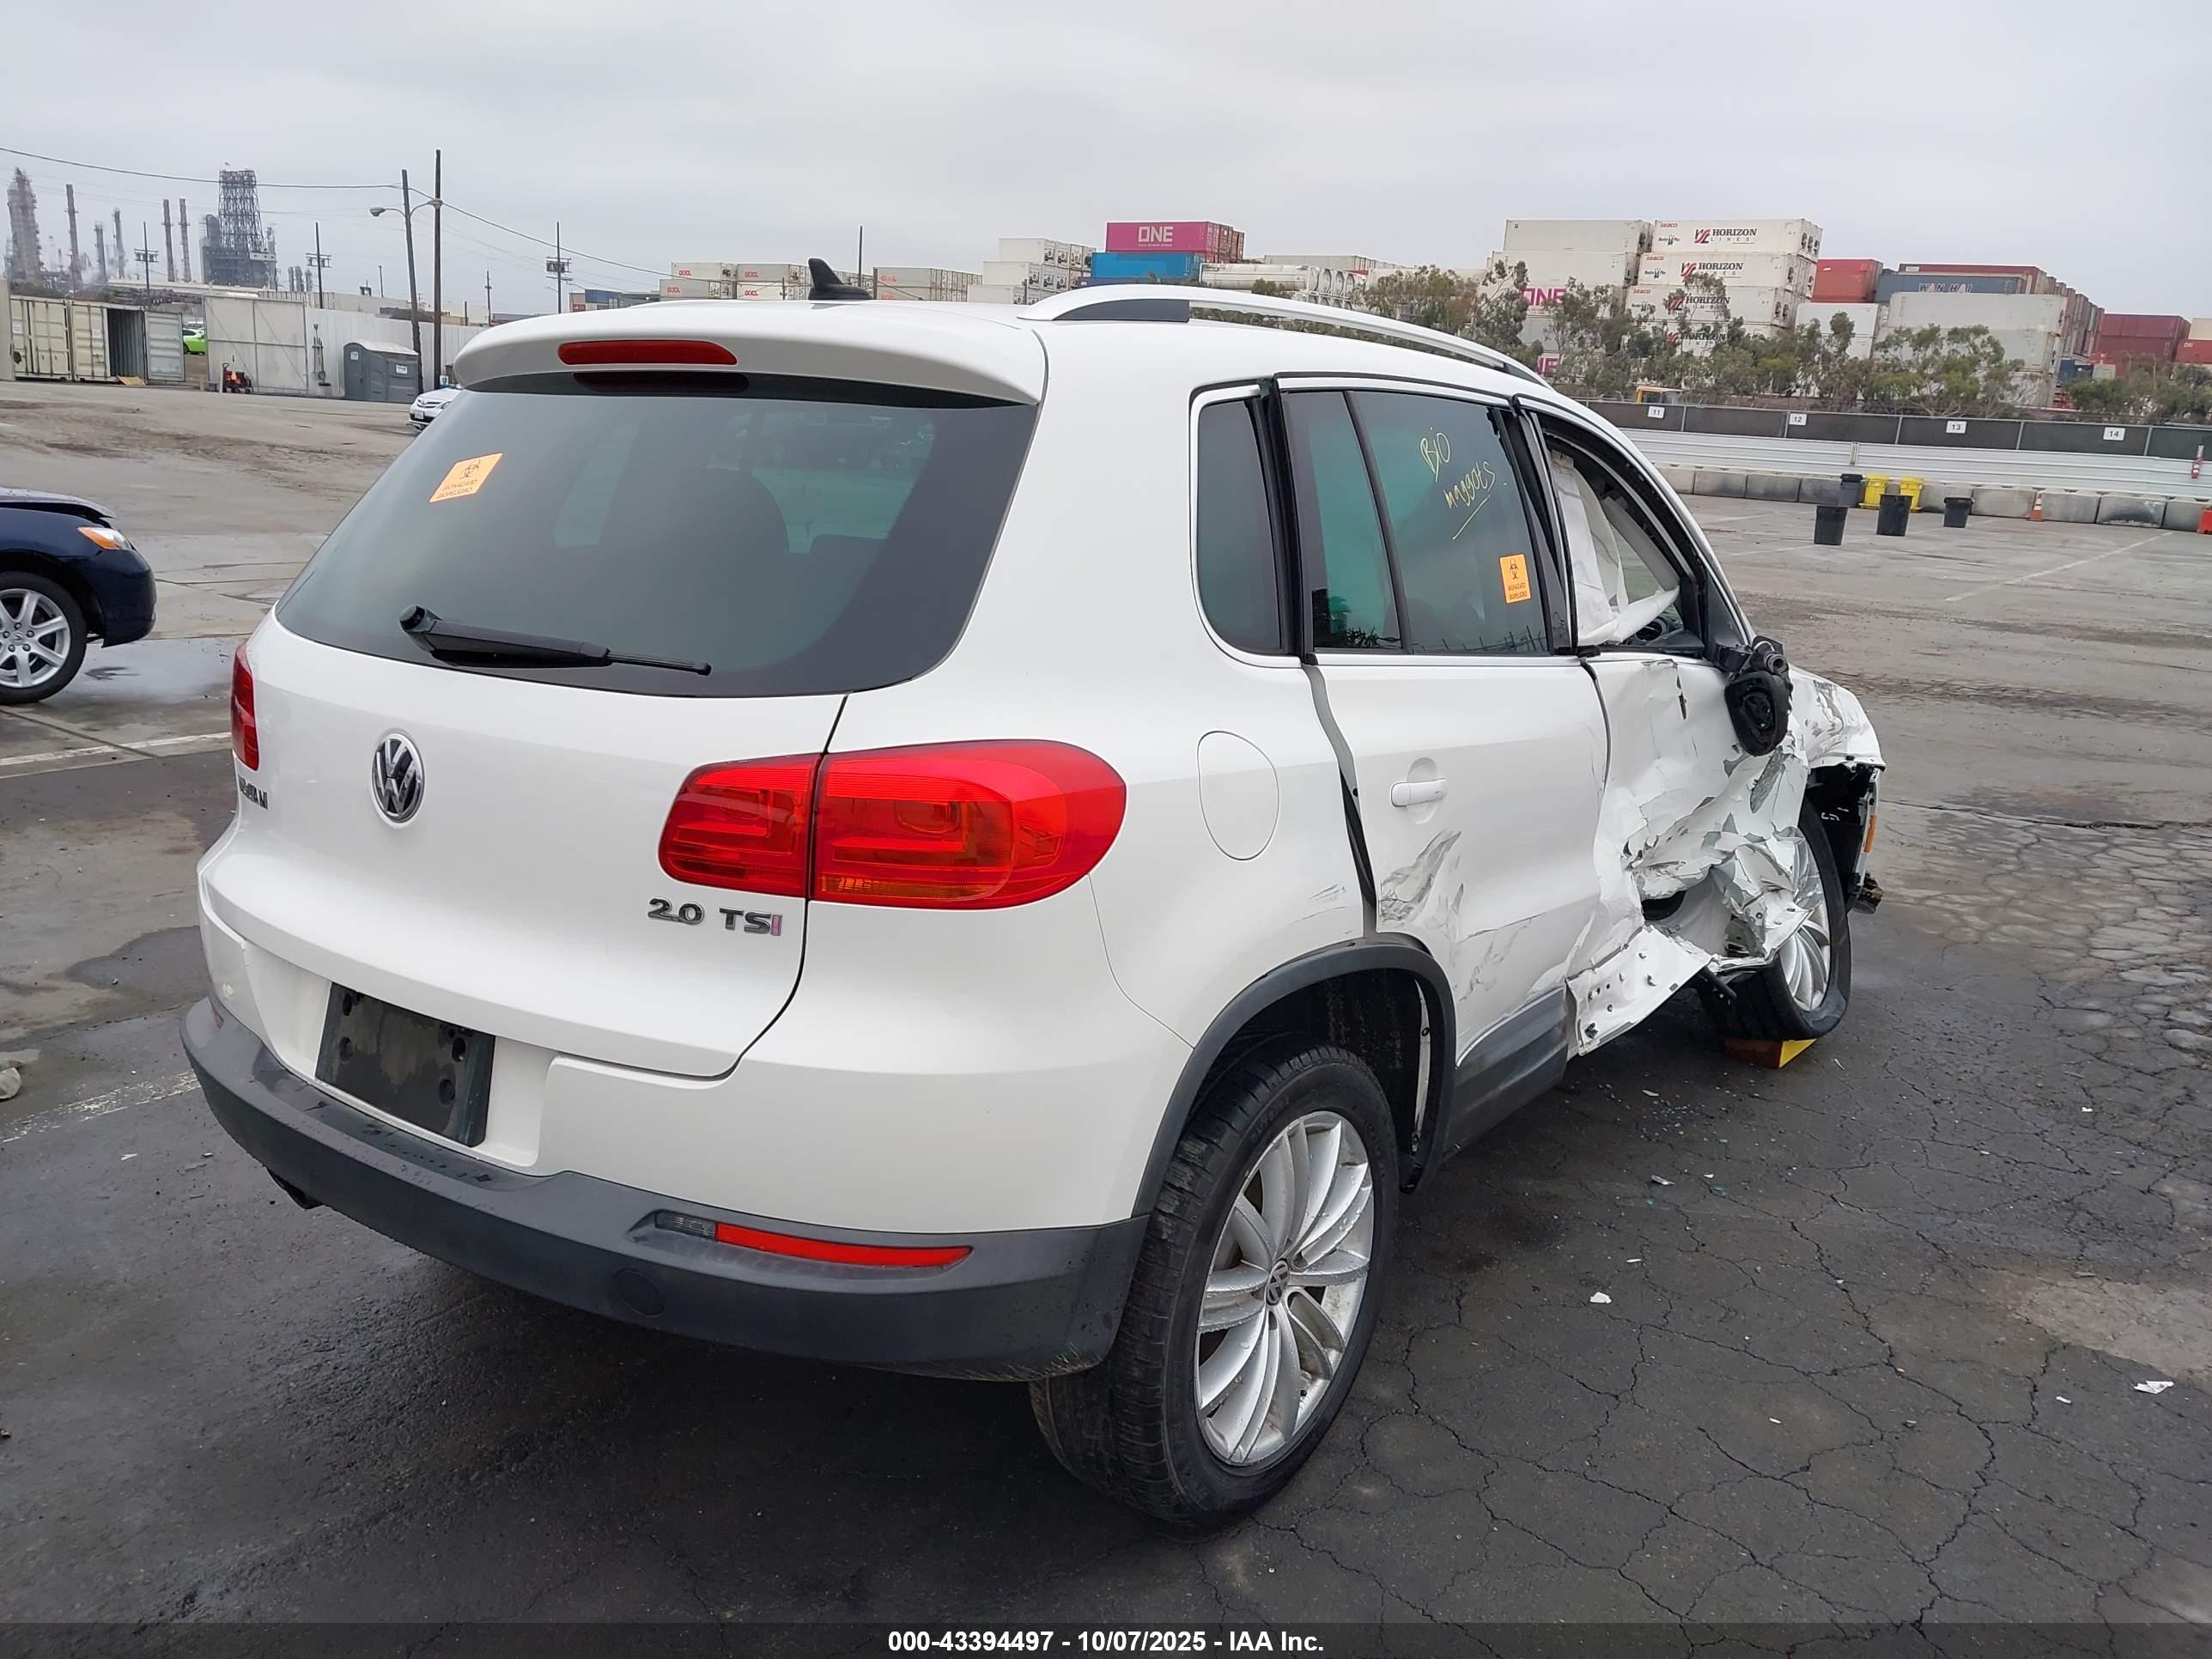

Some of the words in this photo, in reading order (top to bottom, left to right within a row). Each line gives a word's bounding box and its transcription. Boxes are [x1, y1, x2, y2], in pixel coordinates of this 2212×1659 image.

[1138, 226, 1174, 242] ONE
[1698, 262, 1744, 270] HORIZON
[1918, 283, 1946, 293] WAN
[1949, 283, 1973, 293] HAI
[647, 897, 704, 926] 2.0
[719, 906, 783, 936] TSI
